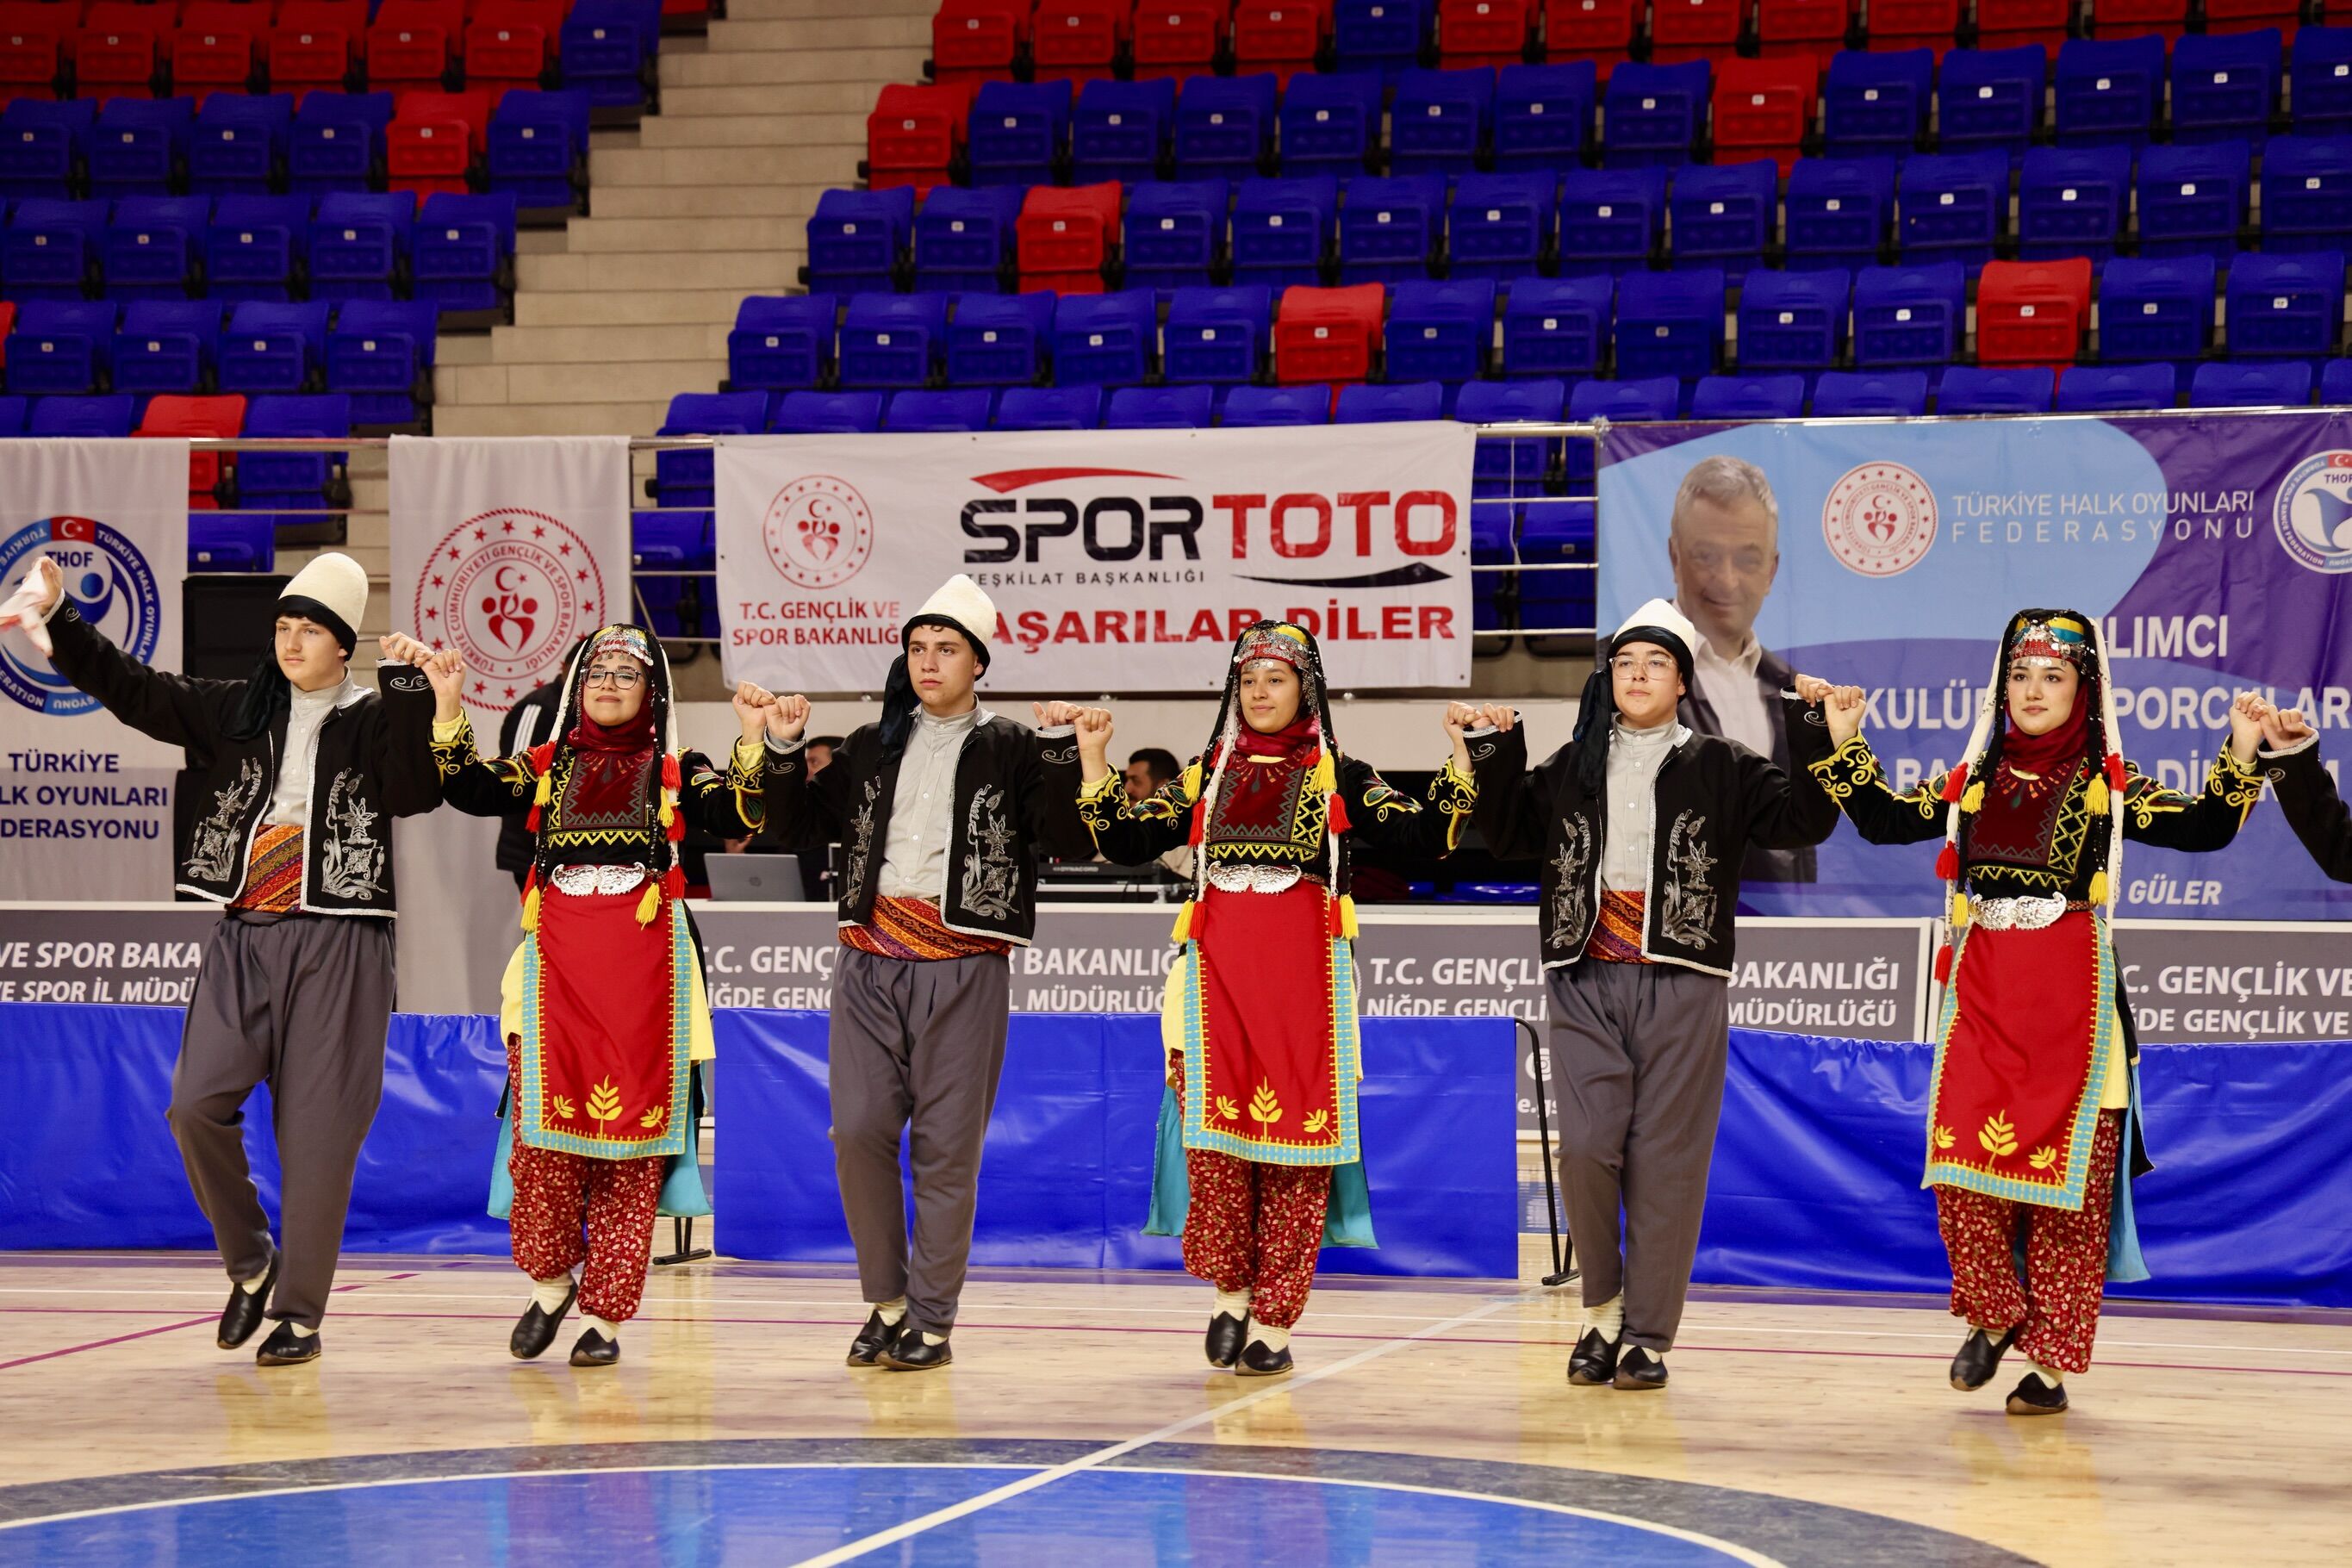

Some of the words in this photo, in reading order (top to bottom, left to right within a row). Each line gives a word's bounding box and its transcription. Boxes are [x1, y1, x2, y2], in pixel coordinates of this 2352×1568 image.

[1951, 490, 2053, 517] TÜRKİYE
[2060, 493, 2125, 516] HALK
[2132, 490, 2255, 515] OYUNLARI
[960, 495, 1204, 563] SPOR
[1211, 490, 1458, 558] TOTO
[1951, 517, 2253, 544] FEDERASYONU
[492, 544, 542, 563] GENÇLİK
[2284, 530, 2324, 566] FEDERATION
[544, 558, 558, 574] VE
[1076, 569, 1204, 586] BAŞKANLIĞI
[136, 569, 154, 603] HALK
[554, 575, 571, 609] SPOR
[739, 602, 776, 619] T.C.
[781, 597, 868, 624] GENÇLİK
[874, 601, 900, 619] VE
[732, 627, 789, 646] SPOR
[793, 624, 900, 645] BAKANLIĞ
[992, 608, 1263, 654] AŞARILAR
[1286, 598, 1456, 641] DİLER
[2099, 614, 2229, 658] LIMCI
[525, 613, 571, 671] BAKANLIĞI
[0, 669, 45, 707] ERATION
[53, 695, 96, 709] SYONU
[8, 749, 120, 773] TÜRKİYE
[0, 786, 29, 806] LK
[36, 786, 168, 806] OYUNLARI
[0, 819, 159, 839] DERASYONU
[2127, 874, 2223, 905] GÜLER
[34, 943, 116, 968] SPOR
[121, 943, 203, 968] BAKA
[703, 946, 743, 974] .C.
[750, 946, 839, 980] GENÇ
[1023, 943, 1180, 976] BAKANLIĞ
[1370, 958, 1424, 985] T.C.
[1431, 955, 1546, 992] GENÇLİ
[2122, 965, 2150, 993] C.
[2158, 961, 2310, 1003] GENÇLİK
[2316, 968, 2352, 997] VE
[0, 980, 16, 1002] E
[21, 980, 87, 1002] SPOR
[92, 976, 114, 1002] İL
[120, 976, 196, 1003] MÜDÜ
[708, 982, 765, 1009] İĞDE
[1453, 994, 1550, 1022] GENÇLİ
[1728, 998, 1897, 1027] MÜDÜRLÜĞÜ
[2183, 1005, 2306, 1040] GENÇLİK
[2312, 1011, 2349, 1035] VE
